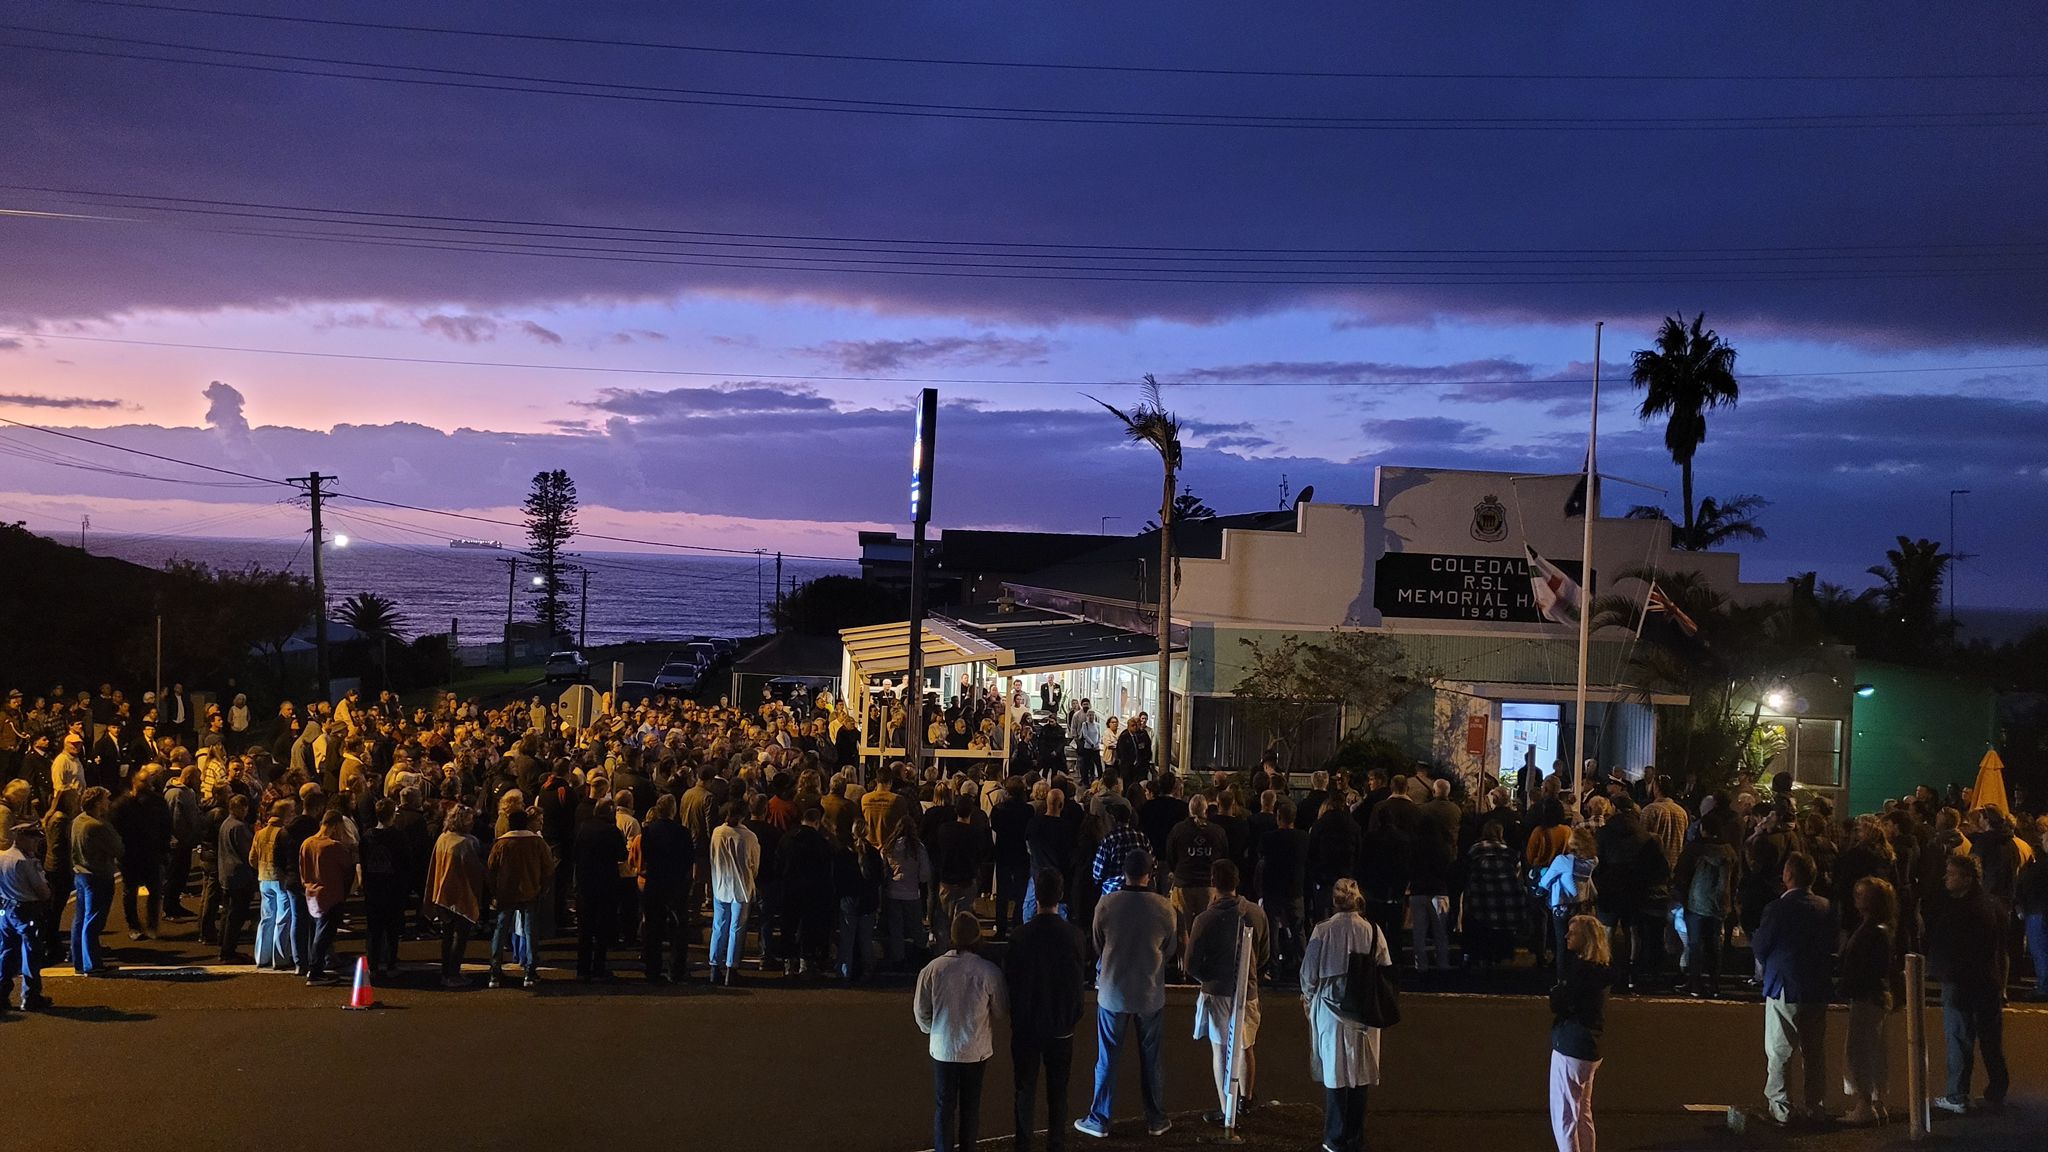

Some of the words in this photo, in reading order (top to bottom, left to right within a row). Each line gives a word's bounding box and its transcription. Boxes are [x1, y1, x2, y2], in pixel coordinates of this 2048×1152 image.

[1431, 557, 1529, 575] COLEDAL
[1398, 588, 1508, 607] MEMORIAL
[1461, 607, 1509, 619] 1948
[1187, 847, 1212, 857] USU
